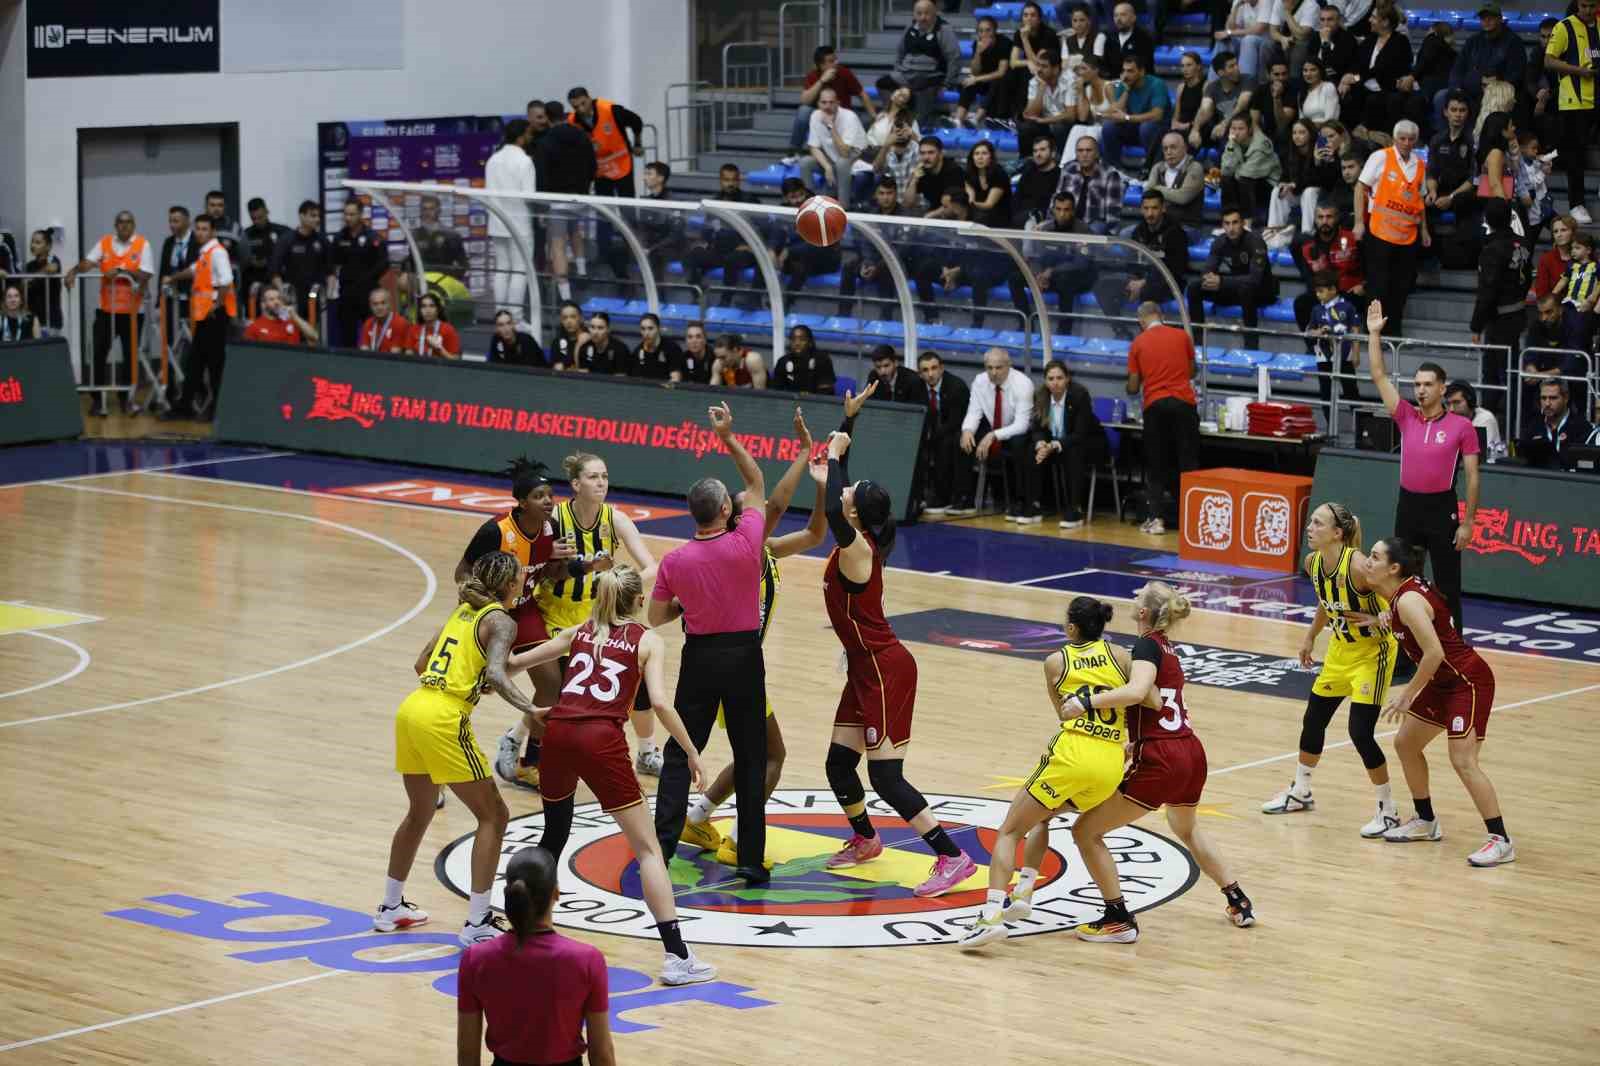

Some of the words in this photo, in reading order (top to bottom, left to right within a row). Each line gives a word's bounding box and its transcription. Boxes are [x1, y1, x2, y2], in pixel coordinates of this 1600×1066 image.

[66, 26, 214, 45] FENERIUM
[390, 396, 427, 421] TAM
[428, 401, 451, 424] 10
[455, 402, 513, 432] YILDIR
[514, 407, 648, 446] BASKETBOLUN
[1512, 519, 1565, 557] ING,
[430, 636, 459, 676] 5
[1073, 654, 1108, 671] ONAR
[561, 652, 629, 702] 23
[1073, 717, 1121, 740] papara
